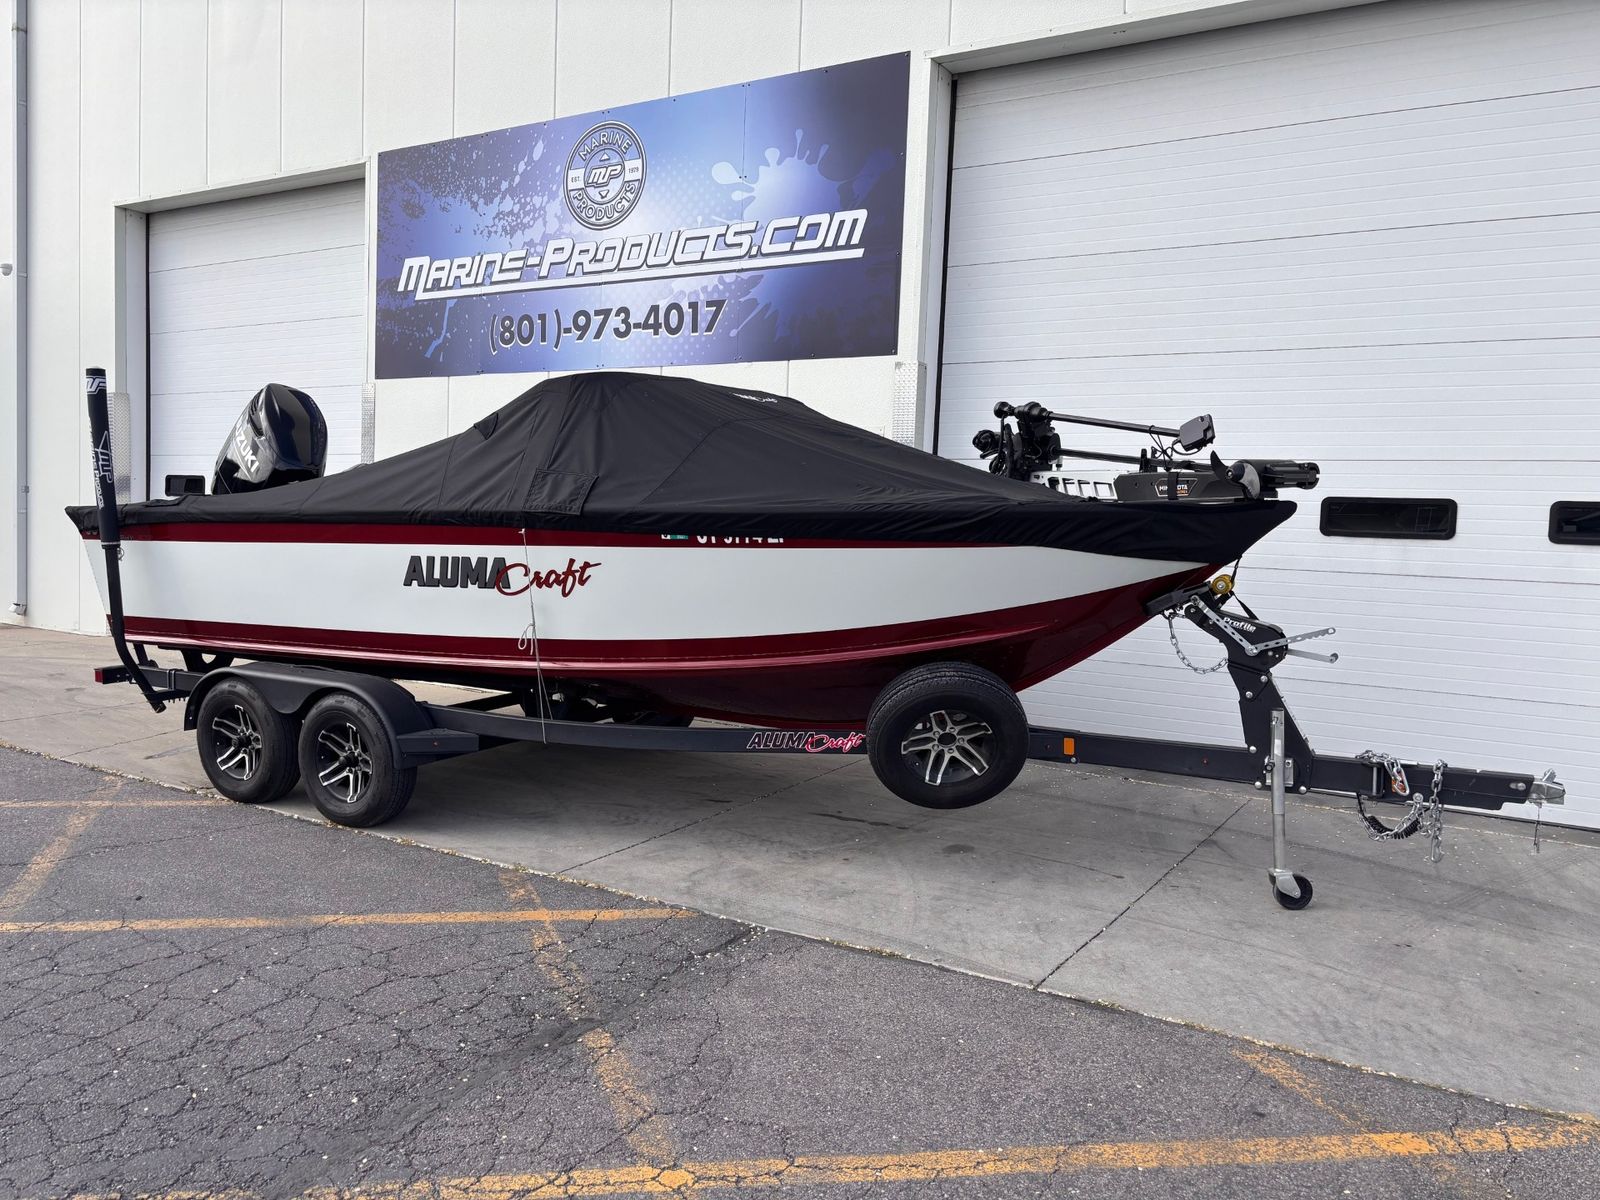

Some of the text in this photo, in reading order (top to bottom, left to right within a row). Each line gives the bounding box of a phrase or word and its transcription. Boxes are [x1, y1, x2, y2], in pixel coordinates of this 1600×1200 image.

[578, 131, 632, 161] MARINE
[573, 182, 637, 221] PRODUCTS
[489, 299, 728, 356] (801)-973-4017
[1222, 616, 1257, 632] Profile
